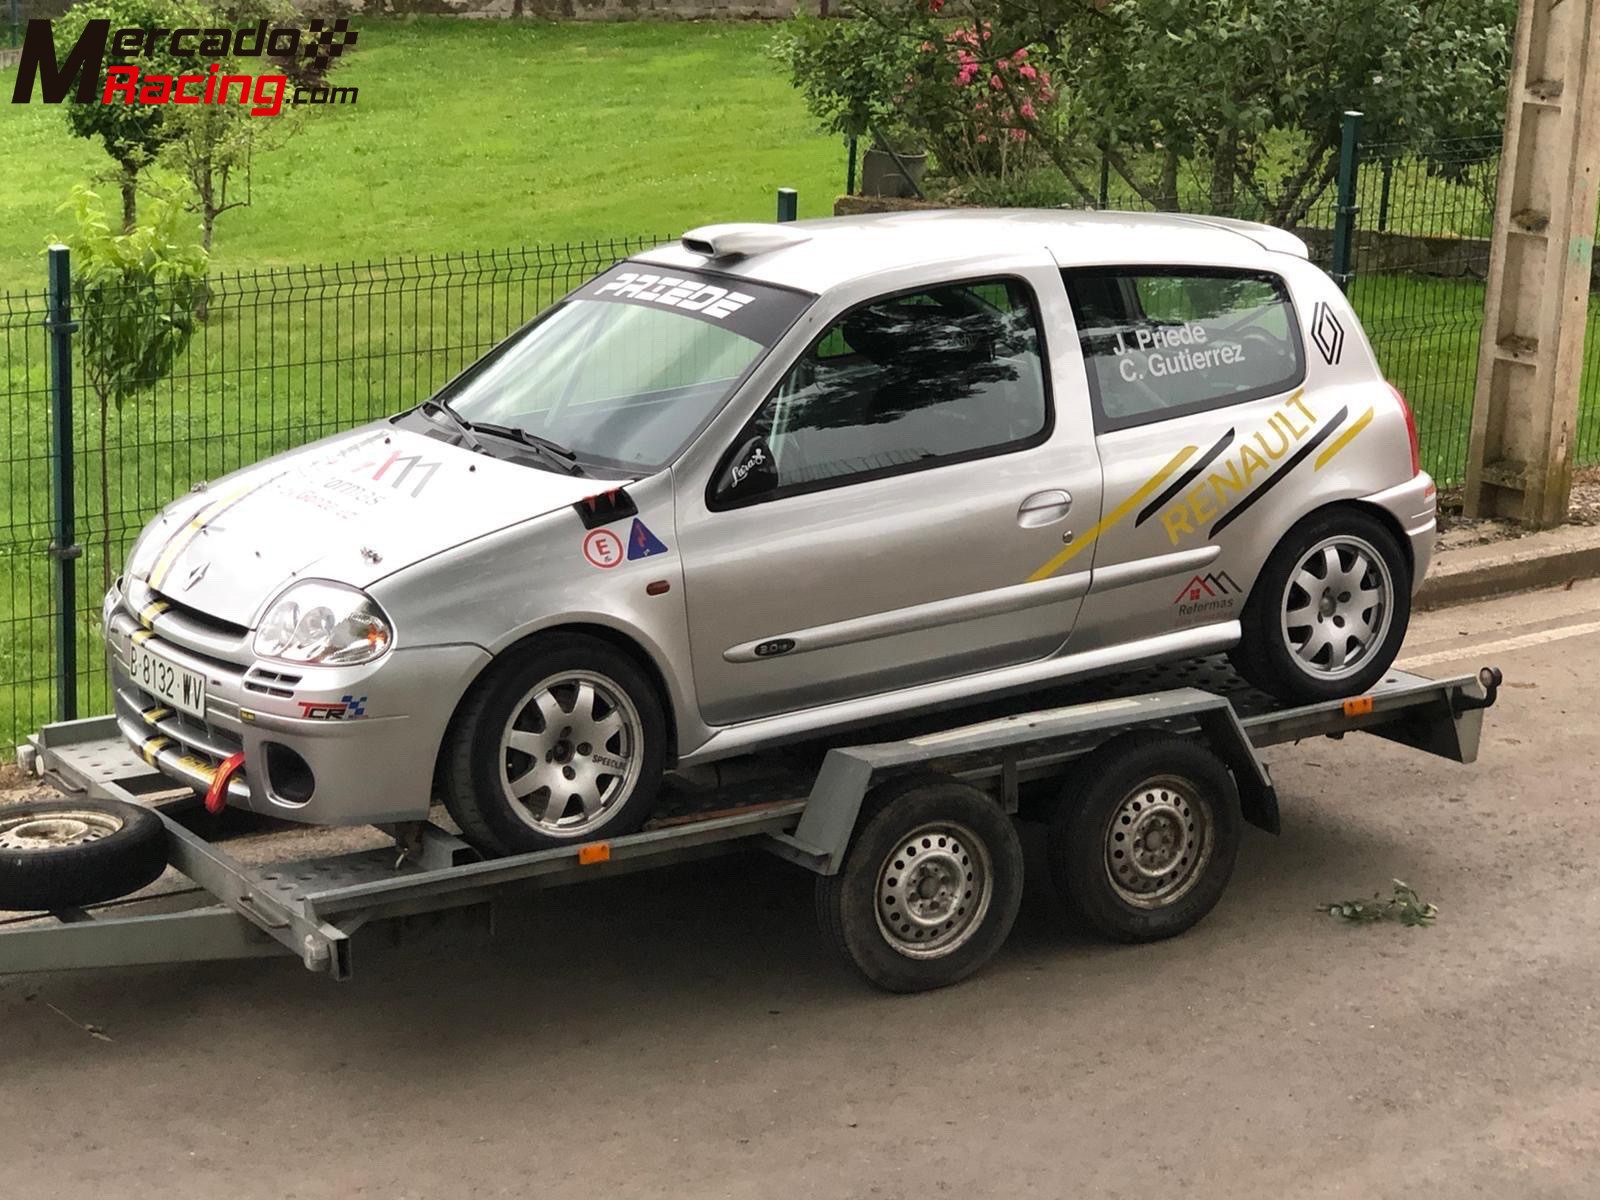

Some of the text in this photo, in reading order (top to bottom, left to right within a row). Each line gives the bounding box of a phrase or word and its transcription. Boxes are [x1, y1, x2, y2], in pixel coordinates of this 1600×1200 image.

[594, 273, 756, 319] PRIEDE
[1113, 322, 1207, 356] J. Priede
[1120, 344, 1246, 382] C. Gutierrez
[1162, 389, 1317, 546] RENAULT
[595, 538, 611, 556] E
[298, 702, 348, 720] TCR
